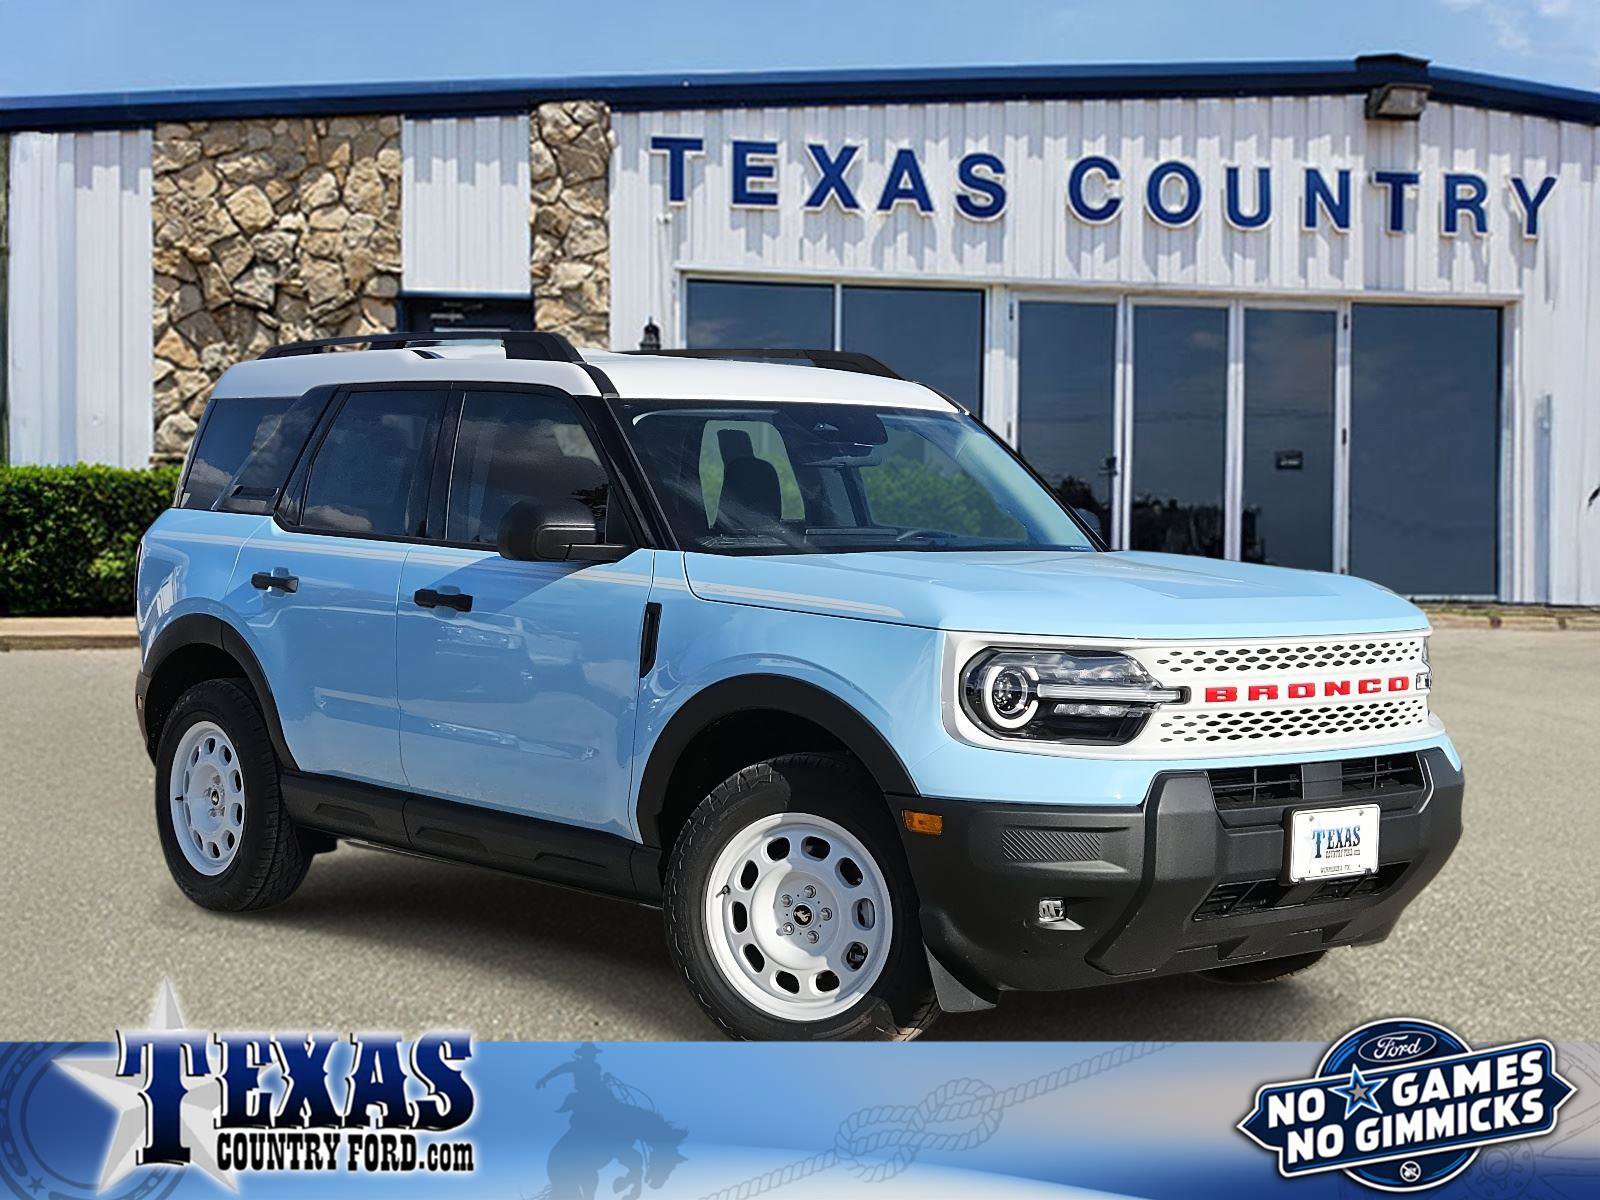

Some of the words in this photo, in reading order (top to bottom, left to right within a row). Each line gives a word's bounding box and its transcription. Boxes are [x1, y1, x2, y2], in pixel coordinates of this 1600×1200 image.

[650, 136, 1006, 220] TEXAS
[1068, 155, 1557, 239] COUNTRY
[1204, 676, 1410, 703] BRONCO
[1312, 825, 1361, 858] TEXAS
